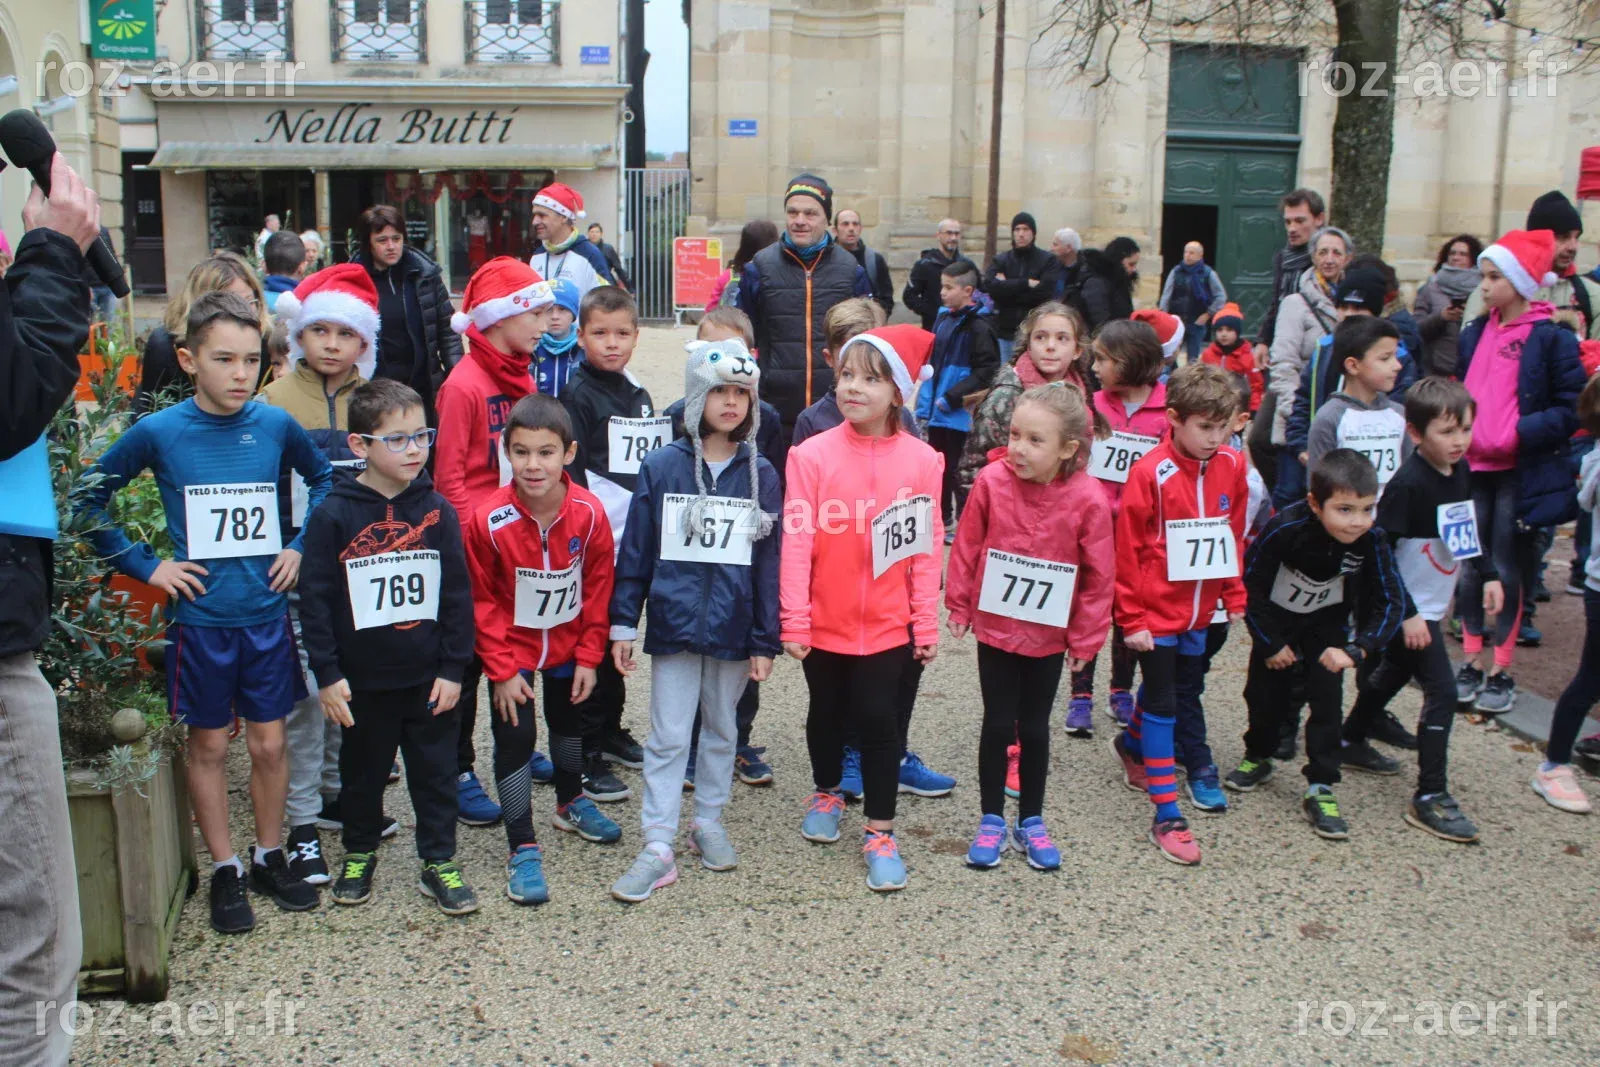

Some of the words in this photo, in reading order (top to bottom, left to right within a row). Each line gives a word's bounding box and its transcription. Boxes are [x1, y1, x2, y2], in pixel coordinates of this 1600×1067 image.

[98, 43, 149, 54] Groupama
[255, 102, 382, 144] Nella
[395, 106, 520, 145] Butti
[188, 487, 211, 496] VELO
[220, 486, 254, 496] Oxygen
[210, 506, 267, 542] 782
[490, 508, 514, 524] BLK
[882, 516, 916, 558] 783
[349, 560, 369, 570] VELO
[378, 555, 411, 564] Oxygen
[989, 551, 1007, 561] VELO
[1015, 557, 1046, 569] Oxygen
[1046, 563, 1075, 574] AUTUN
[1186, 536, 1227, 567] 771
[518, 569, 538, 579] VELO
[370, 573, 425, 611] 769
[536, 580, 577, 617] 772
[1001, 573, 1054, 610] 777
[1287, 582, 1331, 607] 779
